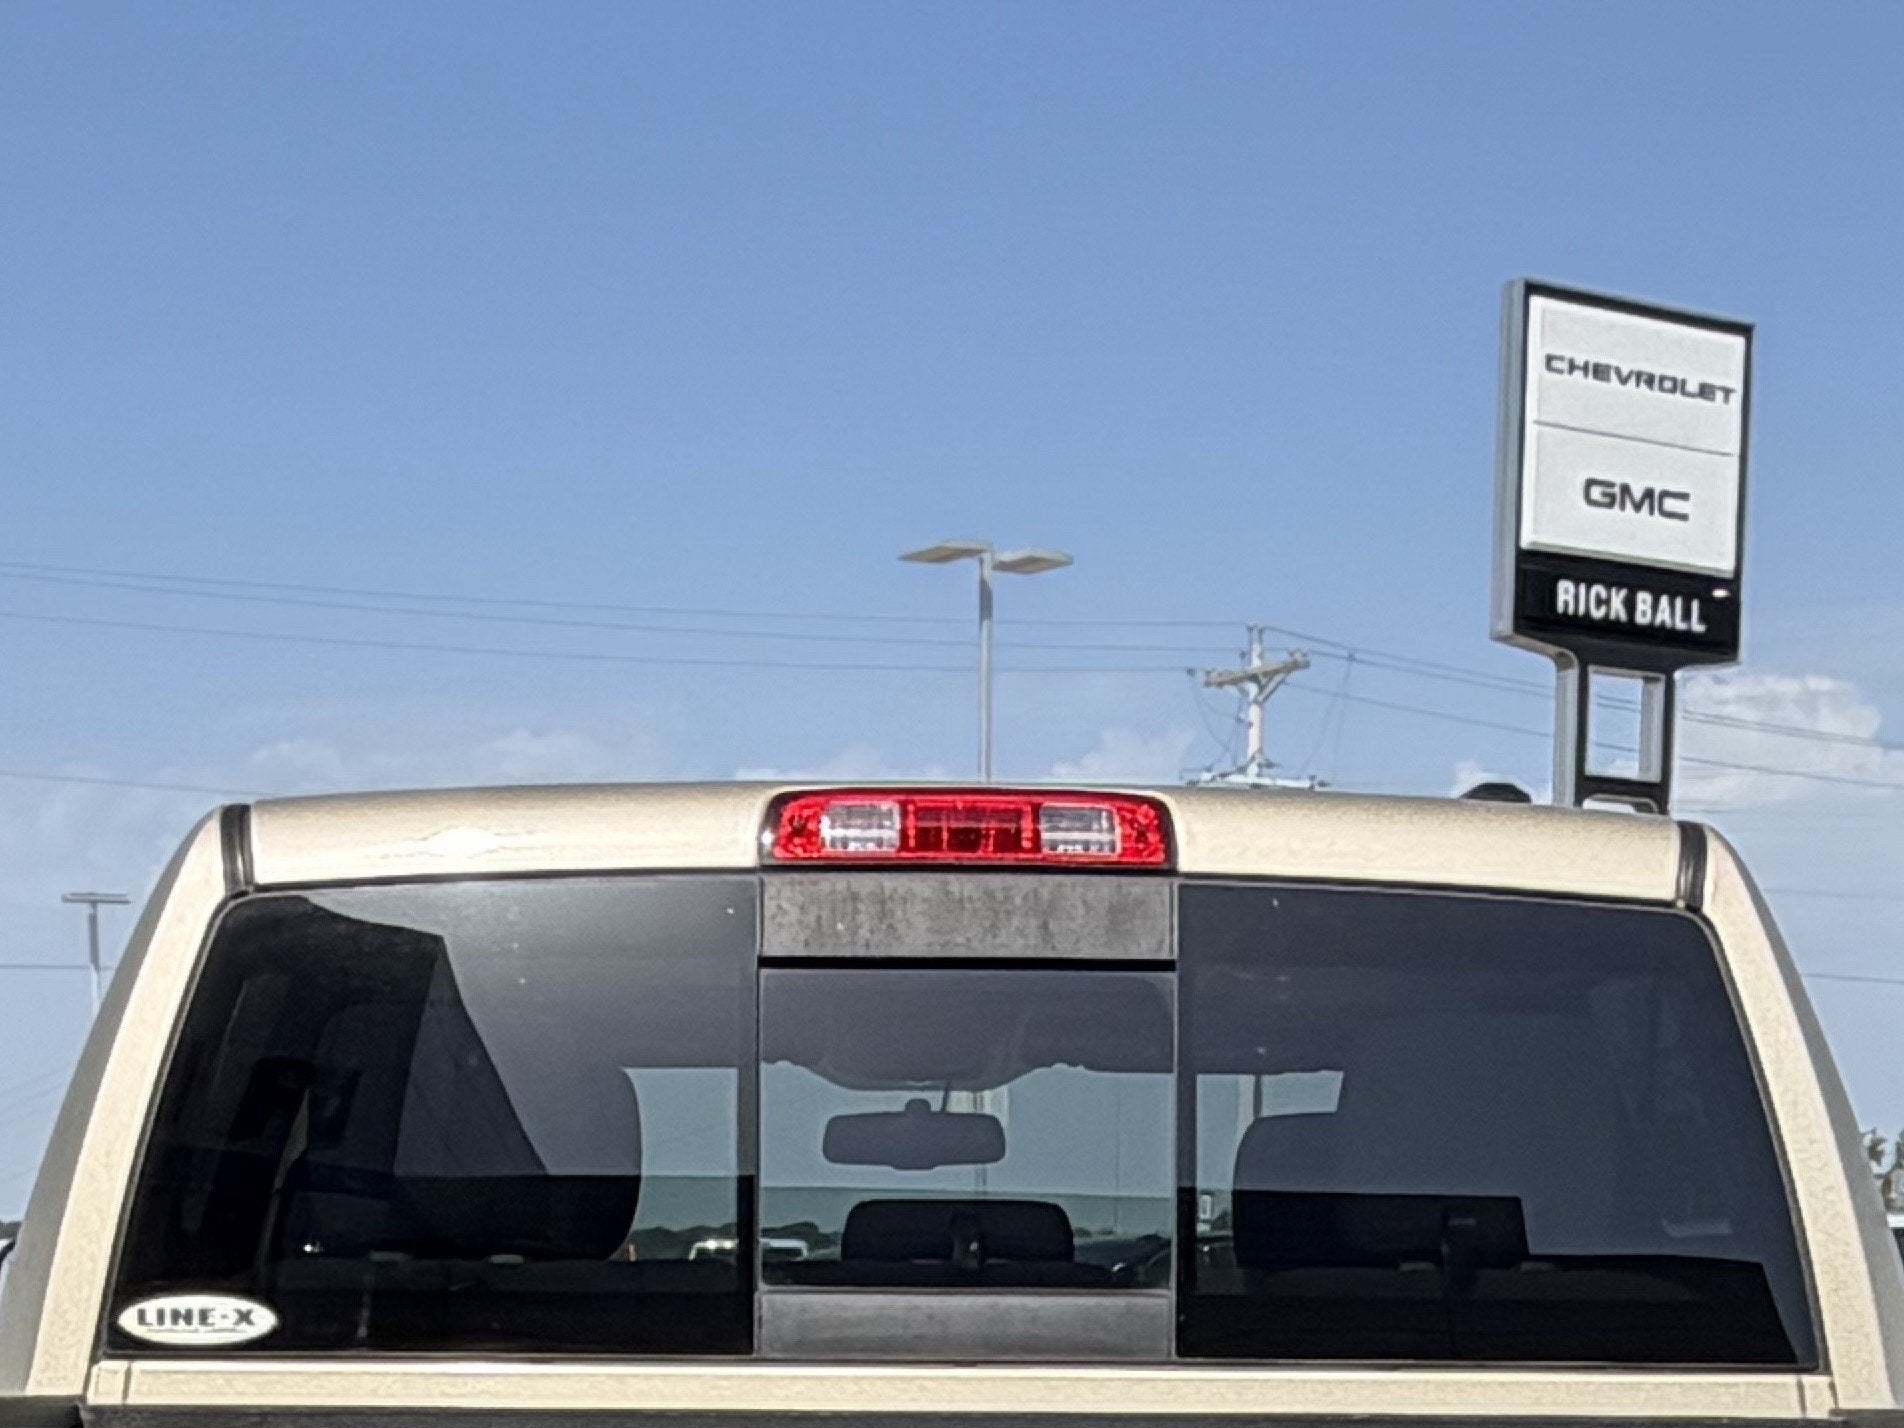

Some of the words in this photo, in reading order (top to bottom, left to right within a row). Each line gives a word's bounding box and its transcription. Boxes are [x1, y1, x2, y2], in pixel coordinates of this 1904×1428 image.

[1543, 352, 1738, 406] CHEVROLET
[1582, 477, 1690, 522] GMC
[1556, 578, 1628, 625] RICK
[1634, 591, 1706, 633] BALL
[136, 1307, 256, 1327] LINE-X
